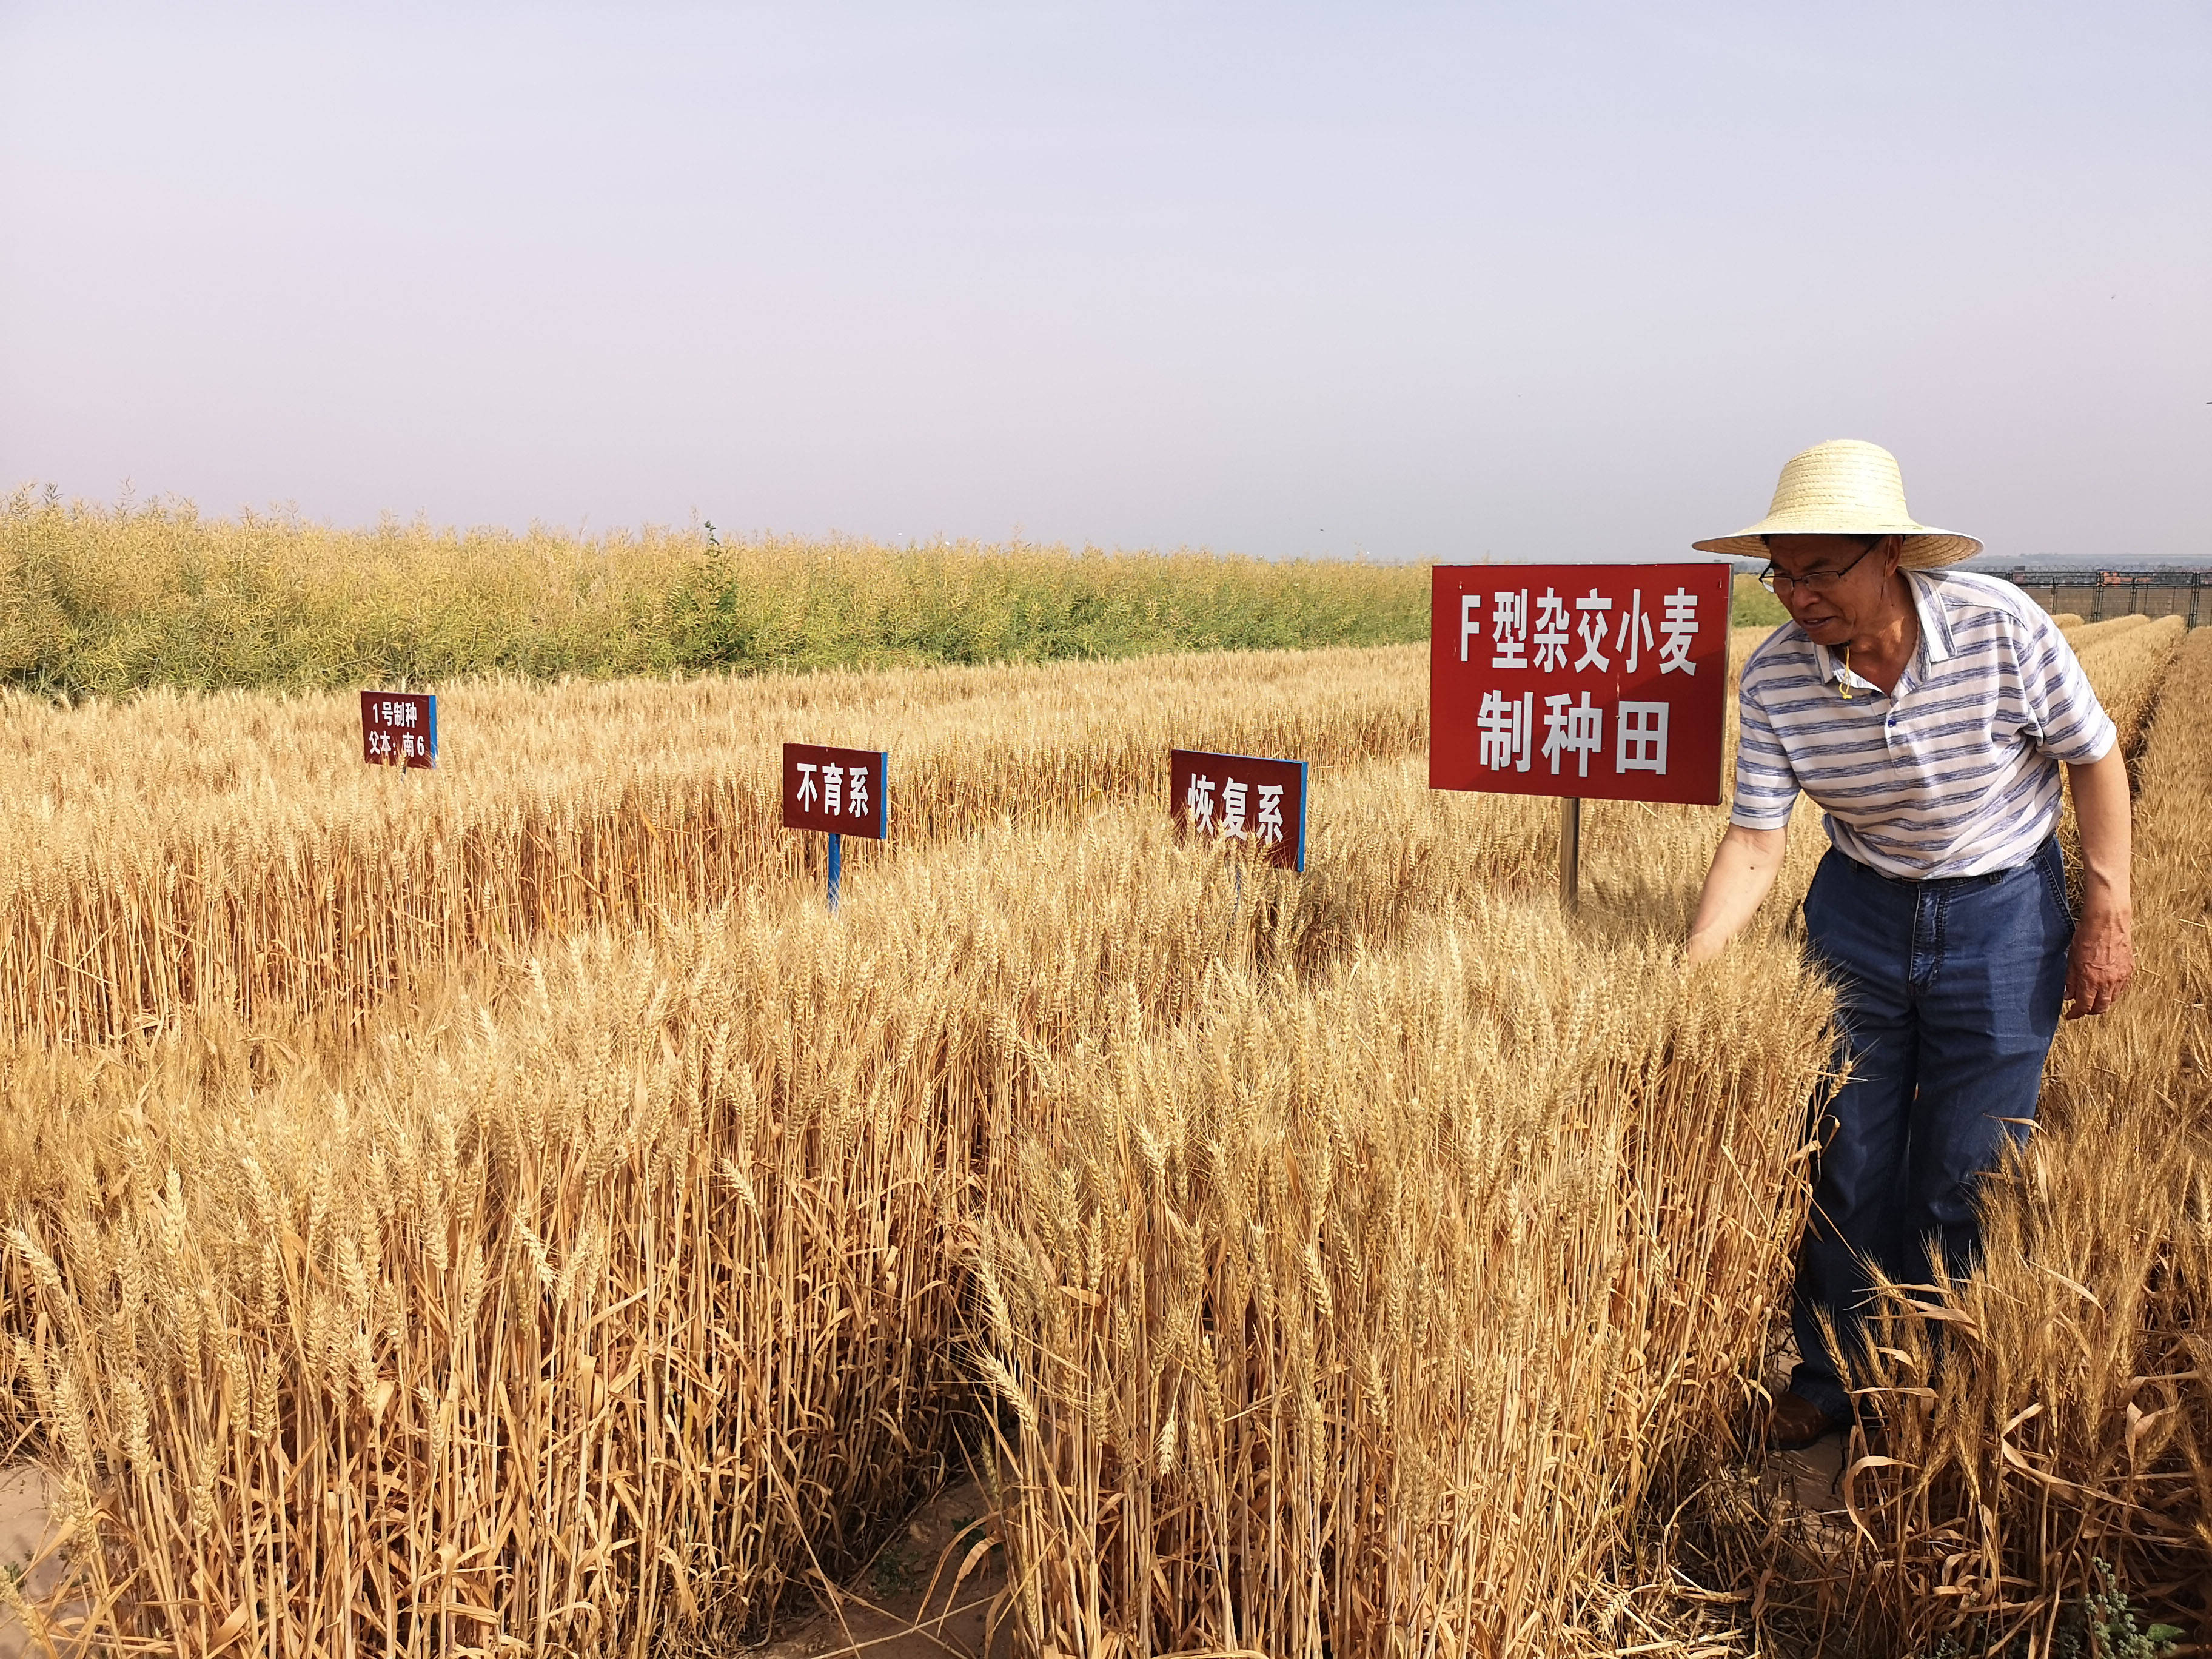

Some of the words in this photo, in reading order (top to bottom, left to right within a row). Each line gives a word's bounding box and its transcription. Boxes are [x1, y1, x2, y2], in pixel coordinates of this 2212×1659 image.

[1460, 587, 1698, 676] F型杂交小麦
[373, 702, 417, 728] 1号制种
[1477, 690, 1669, 777] 制种田
[796, 762, 869, 817] 不育系
[1187, 773, 1284, 845] 恢复系
